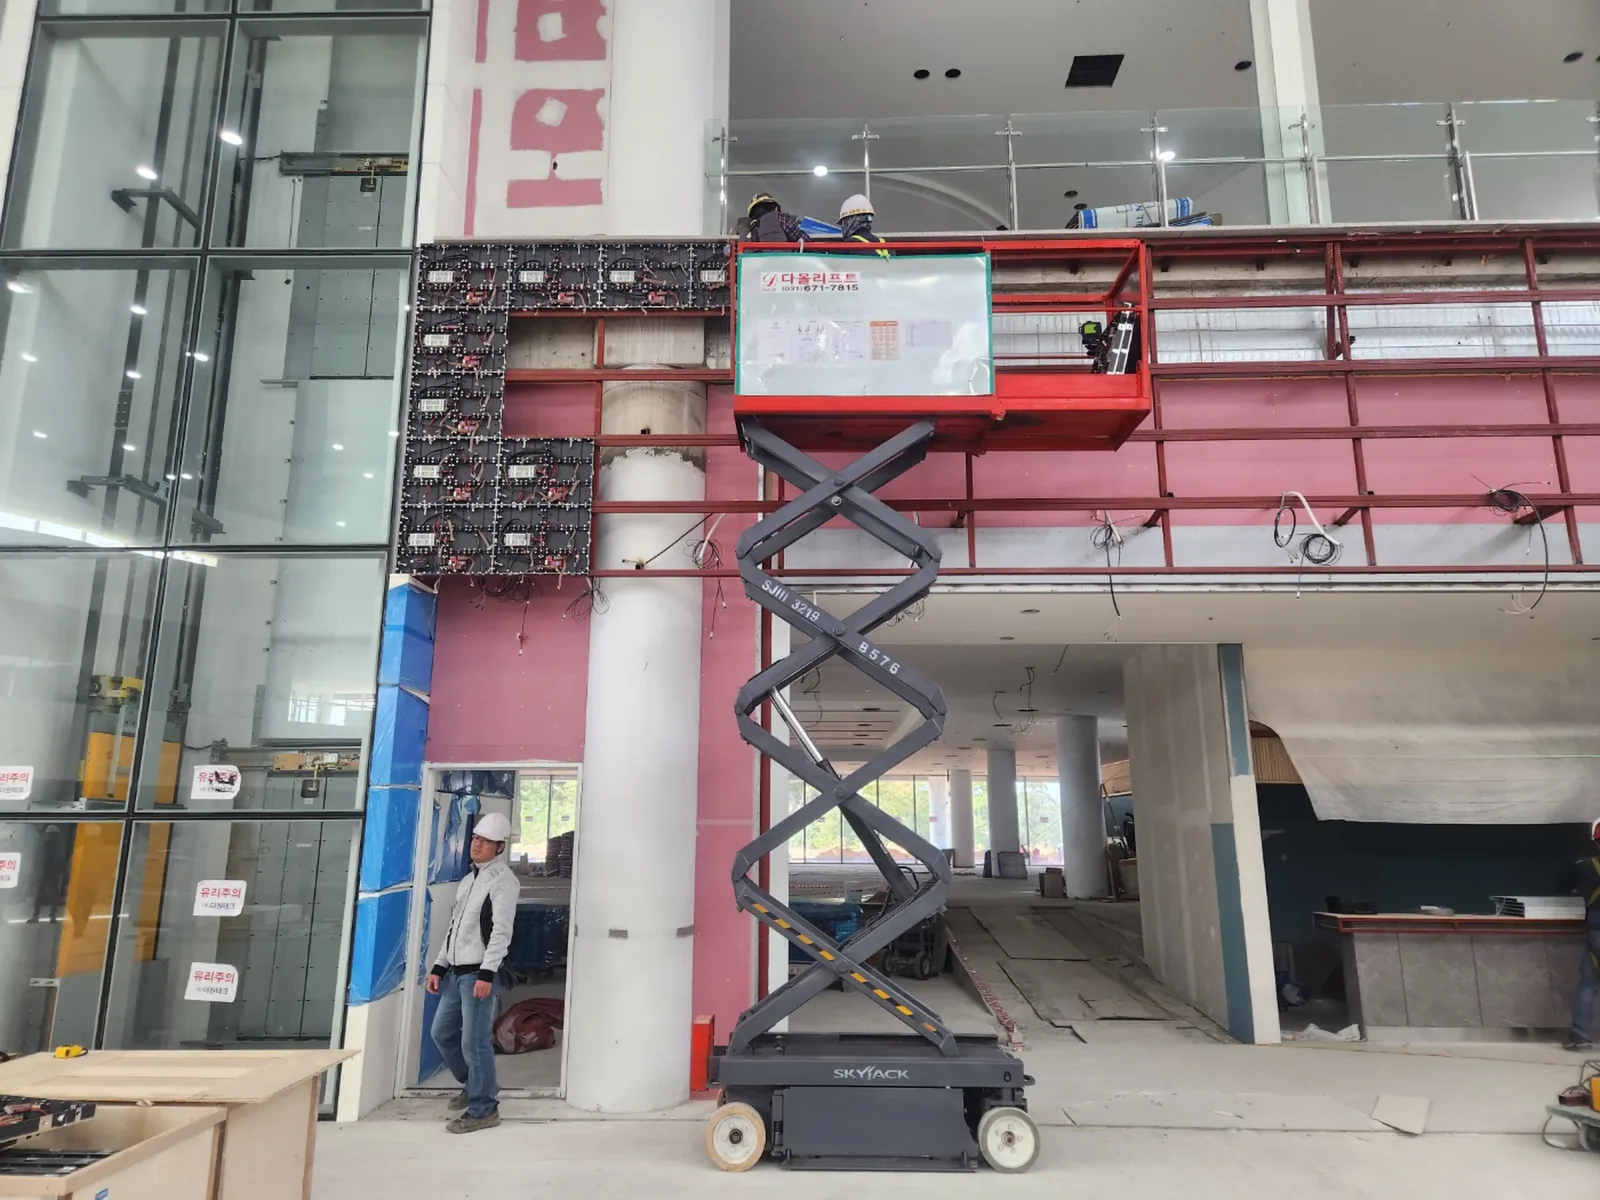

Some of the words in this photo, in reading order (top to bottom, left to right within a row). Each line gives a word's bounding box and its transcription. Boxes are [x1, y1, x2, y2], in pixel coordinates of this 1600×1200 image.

[791, 598, 821, 622] 3219
[200, 887, 242, 899] 유리주의
[193, 970, 236, 984] 유리주의
[833, 1065, 909, 1080] SKYJACK
